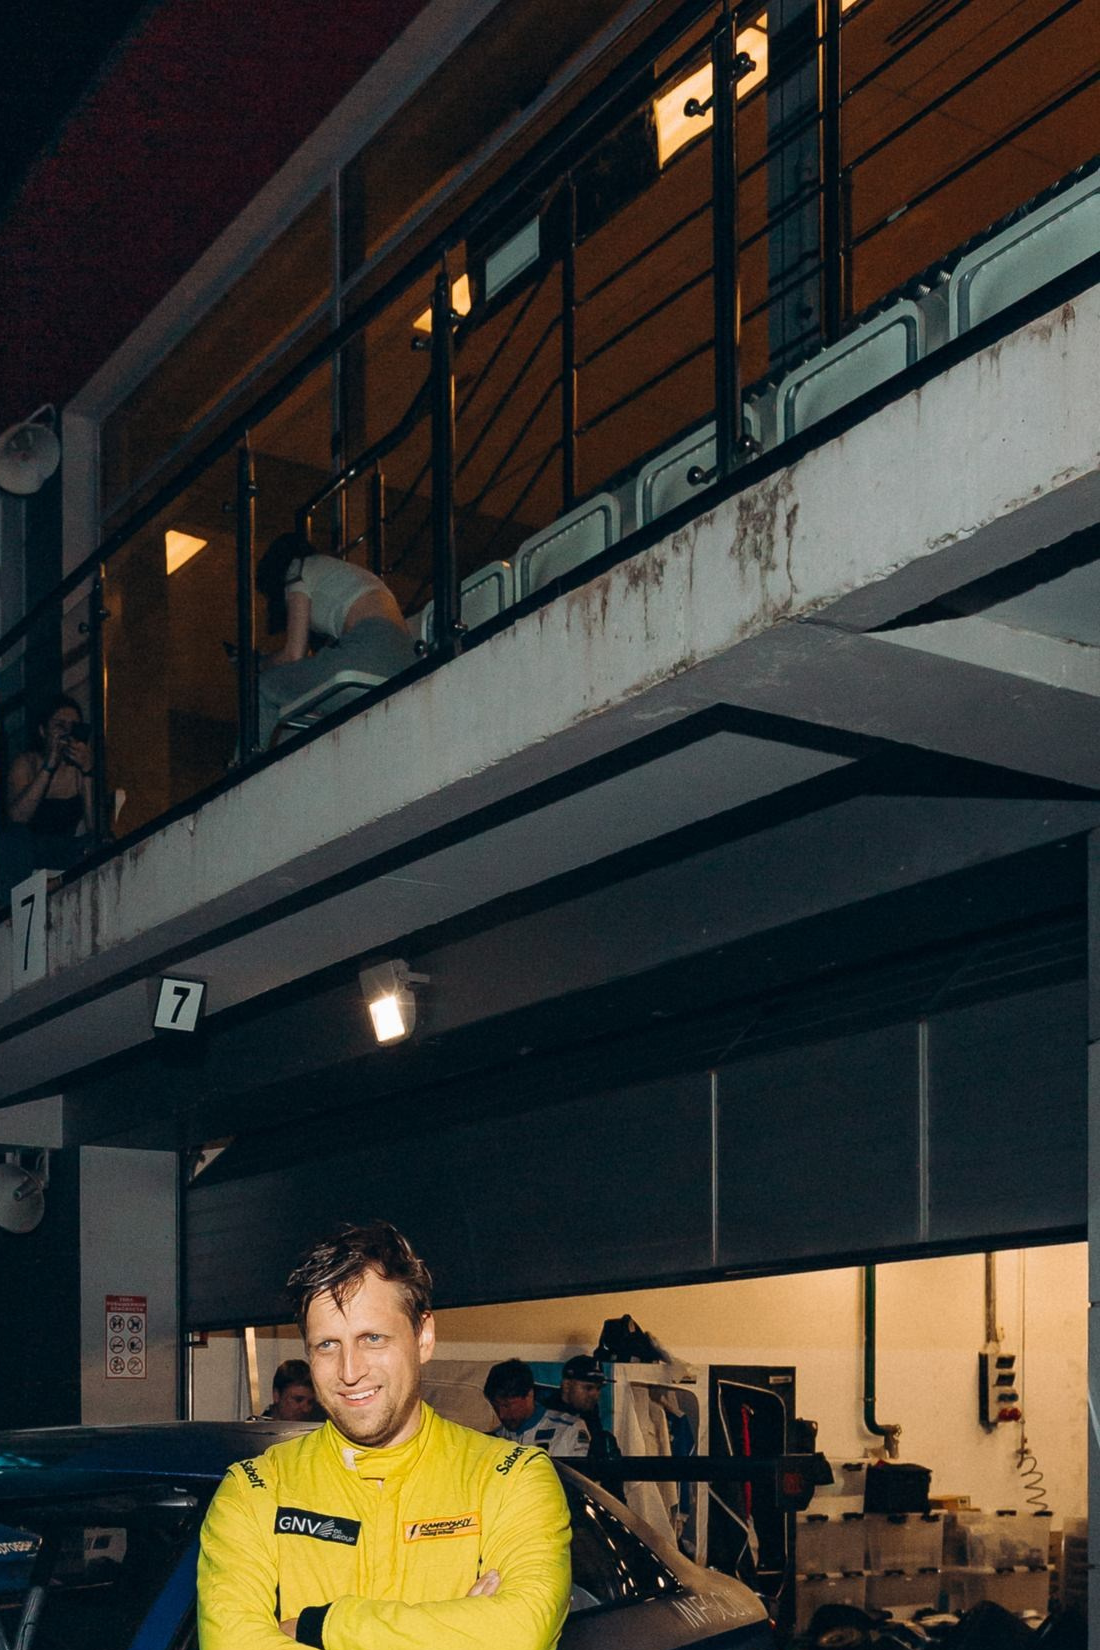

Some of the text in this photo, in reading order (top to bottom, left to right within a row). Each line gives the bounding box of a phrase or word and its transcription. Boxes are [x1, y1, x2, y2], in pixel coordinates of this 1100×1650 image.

[20, 893, 35, 971] 7
[170, 986, 191, 1024] 7
[496, 1446, 528, 1475] Sabelt
[279, 1516, 321, 1534] GNV
[420, 1517, 472, 1531] KAMENSKIY
[331, 1533, 355, 1542] GROUP
